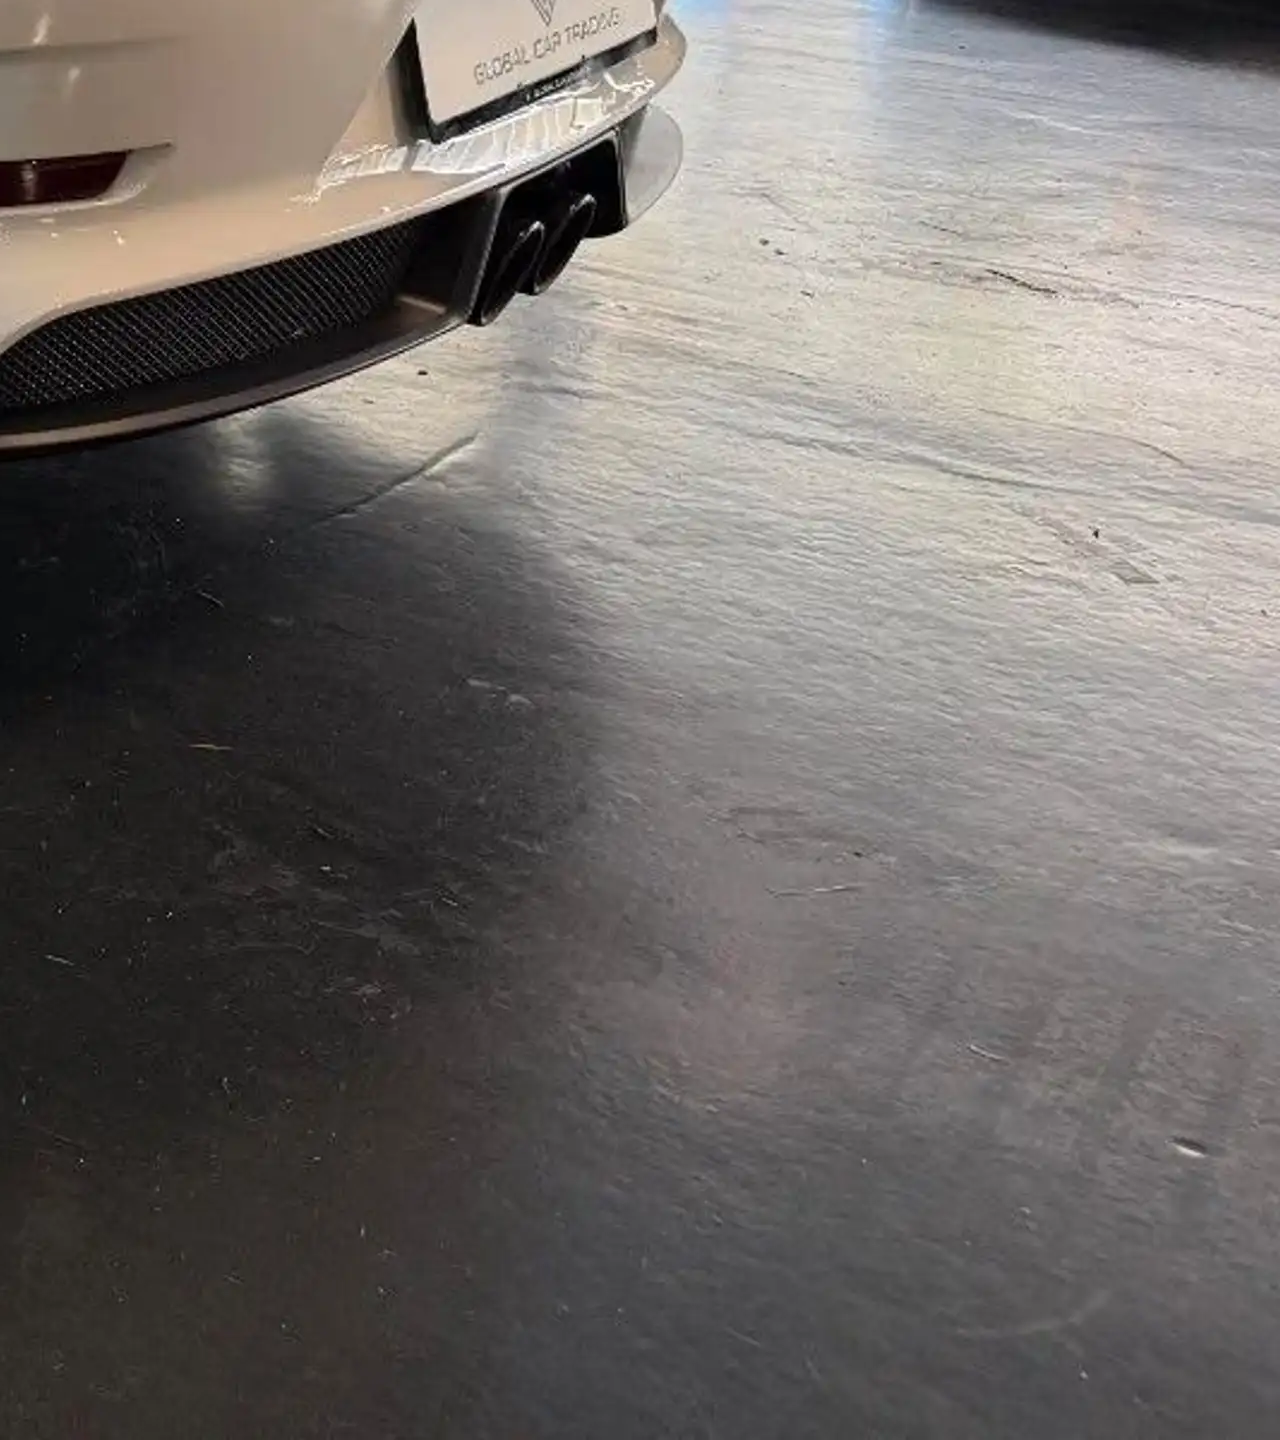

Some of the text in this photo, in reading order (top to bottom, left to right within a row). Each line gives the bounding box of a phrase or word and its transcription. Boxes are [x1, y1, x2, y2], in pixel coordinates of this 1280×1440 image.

[473, 6, 621, 85] GLOBAL CAR TRADING
